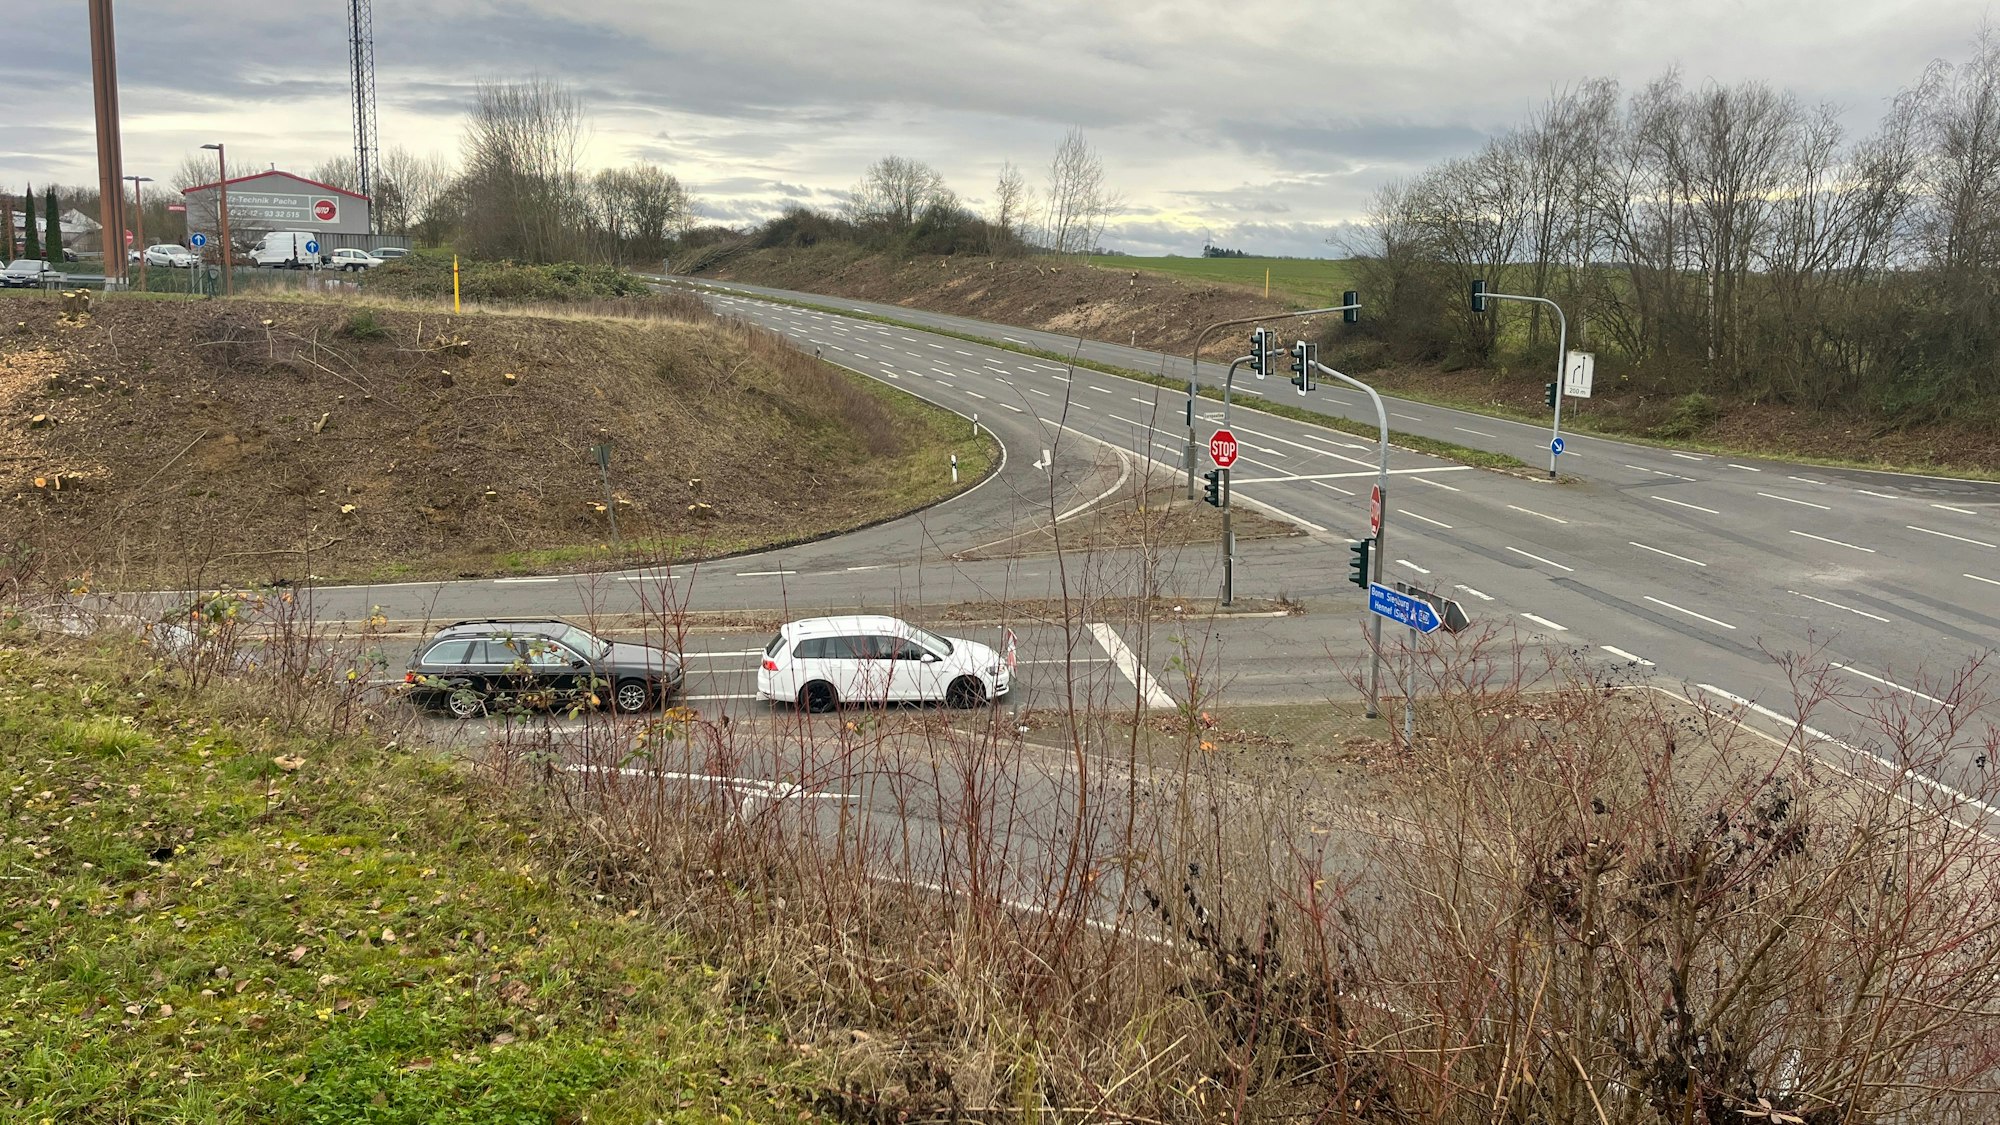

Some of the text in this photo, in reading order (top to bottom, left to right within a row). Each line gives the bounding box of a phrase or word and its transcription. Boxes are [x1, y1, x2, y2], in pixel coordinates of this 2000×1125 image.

[273, 197, 297, 205] Pacha
[264, 210, 273, 218] 93
[1212, 440, 1235, 458] STOP
[1371, 586, 1409, 611] Bonn Siegburg
[1374, 600, 1392, 615] Hennef
